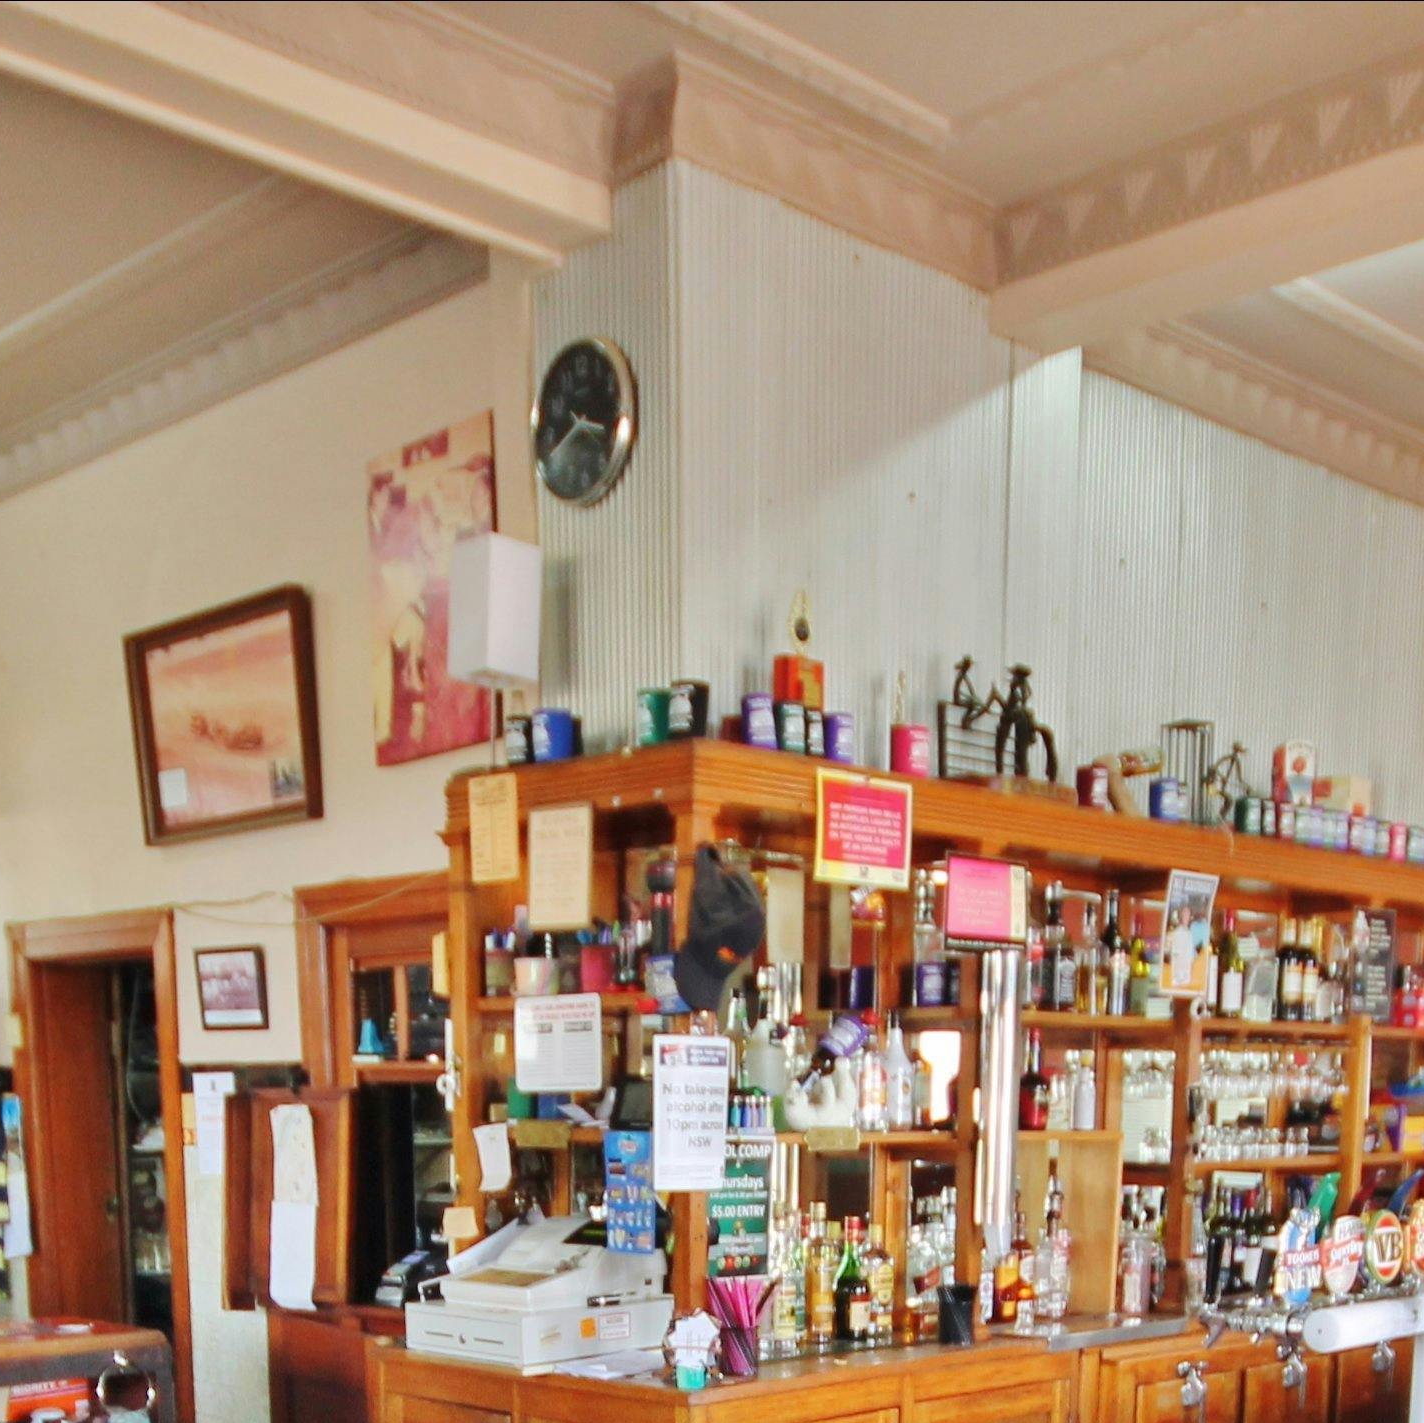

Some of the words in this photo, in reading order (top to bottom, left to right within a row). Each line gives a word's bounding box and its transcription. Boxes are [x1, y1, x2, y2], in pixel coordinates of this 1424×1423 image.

[662, 1083, 681, 1095] No
[666, 1101, 706, 1113] alcohol
[708, 1102, 724, 1113] afte
[666, 1119, 699, 1132] 10pm
[700, 1121, 724, 1131] acros
[688, 1136, 712, 1148] NSW
[738, 1144, 771, 1157] COMP
[723, 1174, 764, 1190] hursdays
[711, 1205, 736, 1218] $5.00
[737, 1204, 766, 1217] ENTRY
[1374, 1232, 1402, 1261] VB
[1287, 1265, 1322, 1289] NEW
